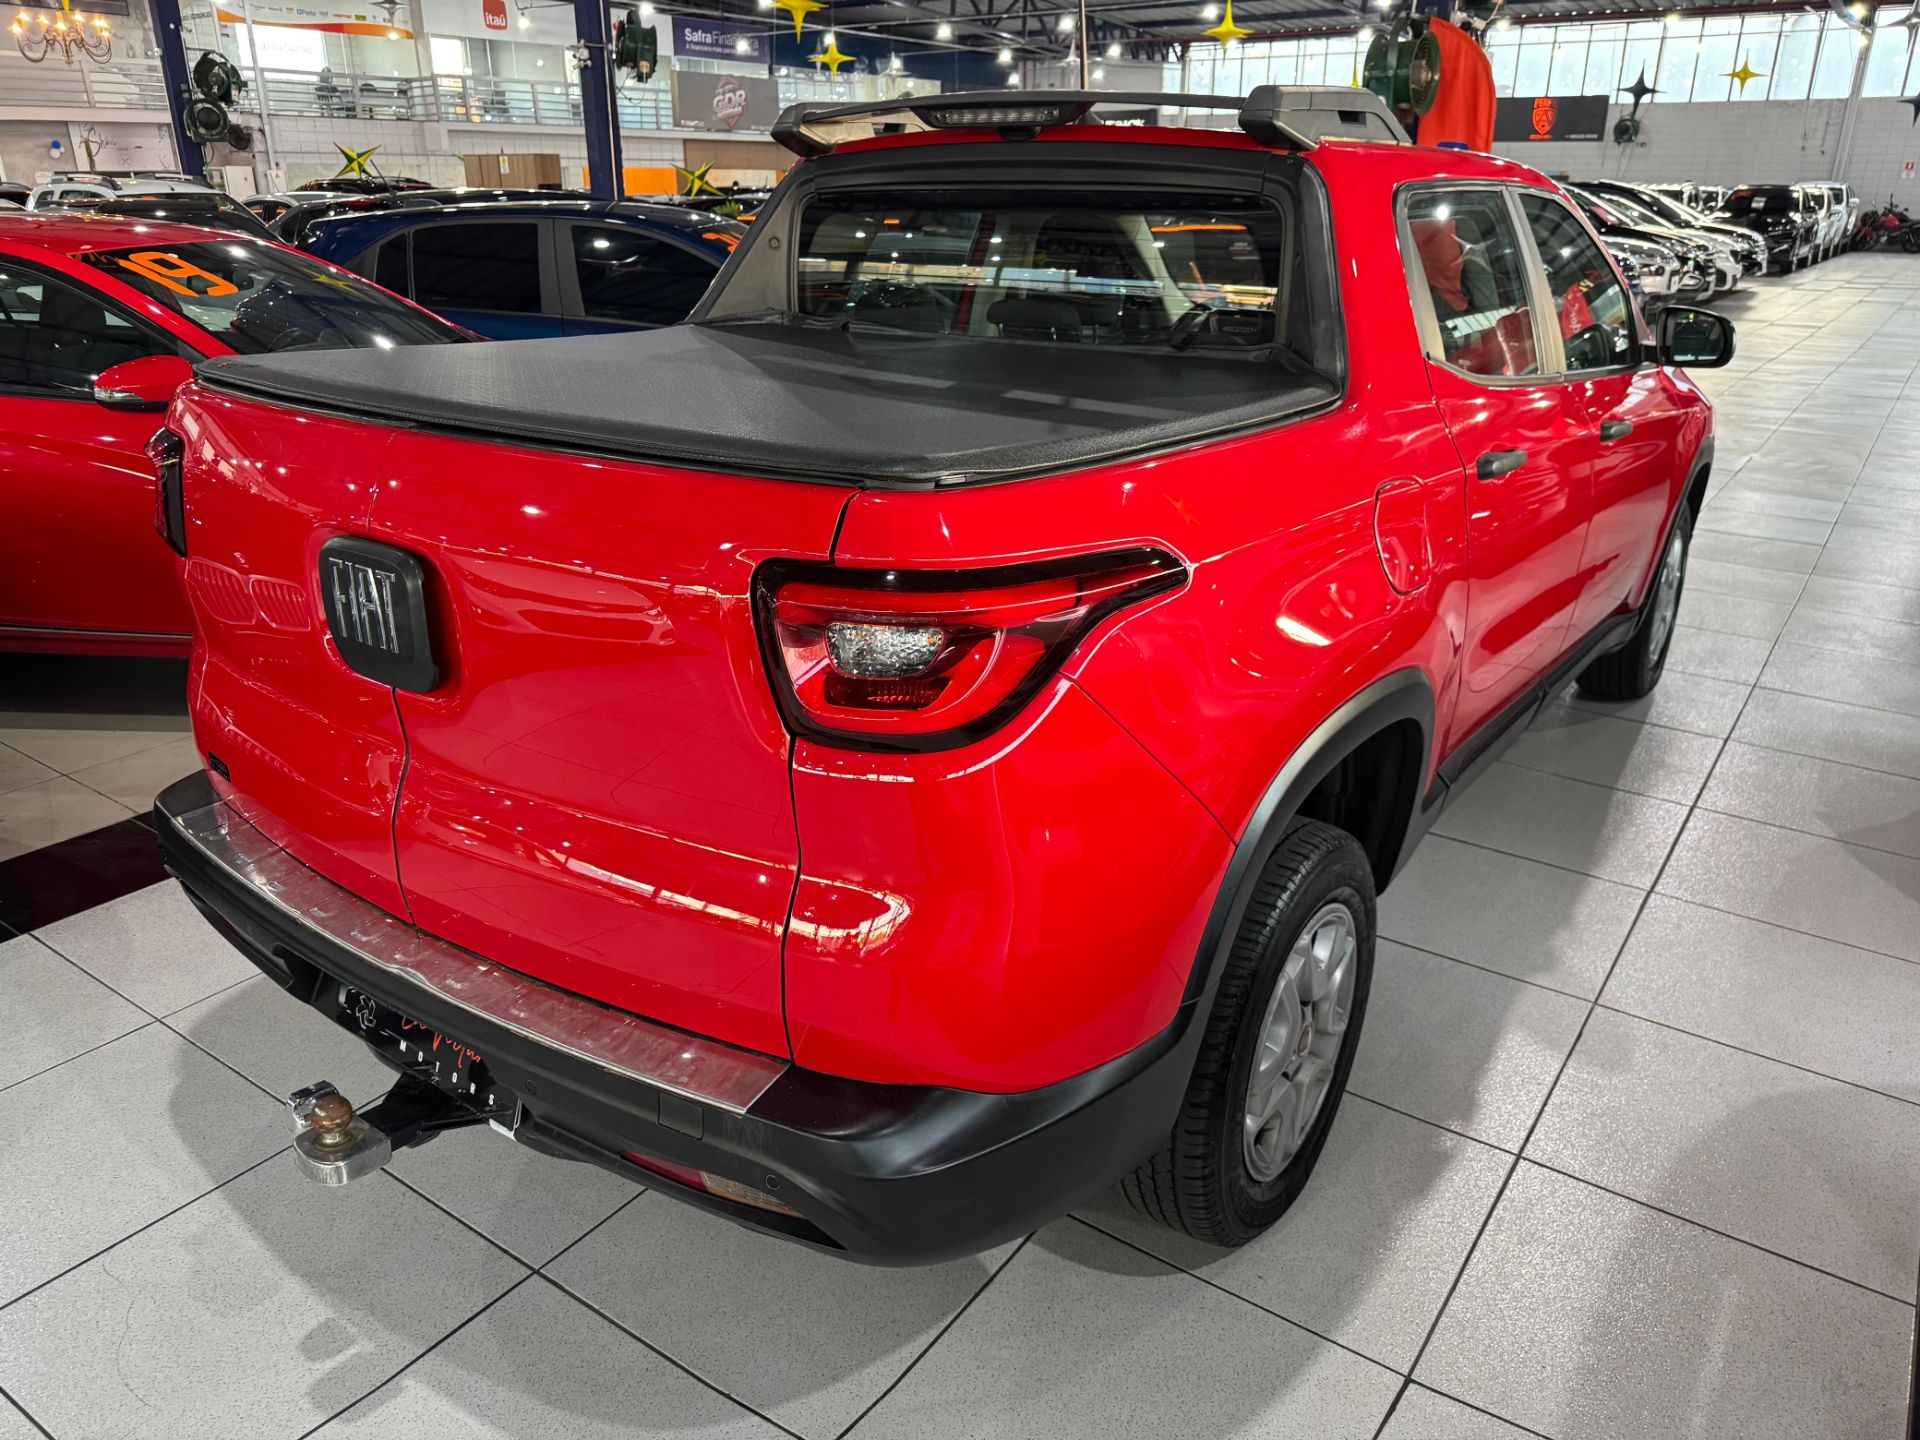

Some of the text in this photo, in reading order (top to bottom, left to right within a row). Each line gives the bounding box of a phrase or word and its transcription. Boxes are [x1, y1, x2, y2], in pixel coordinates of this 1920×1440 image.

[485, 12, 506, 26] itaú
[713, 89, 746, 113] GDR
[328, 556, 397, 654] FIAT
[399, 1039, 495, 1105] MOTORS
